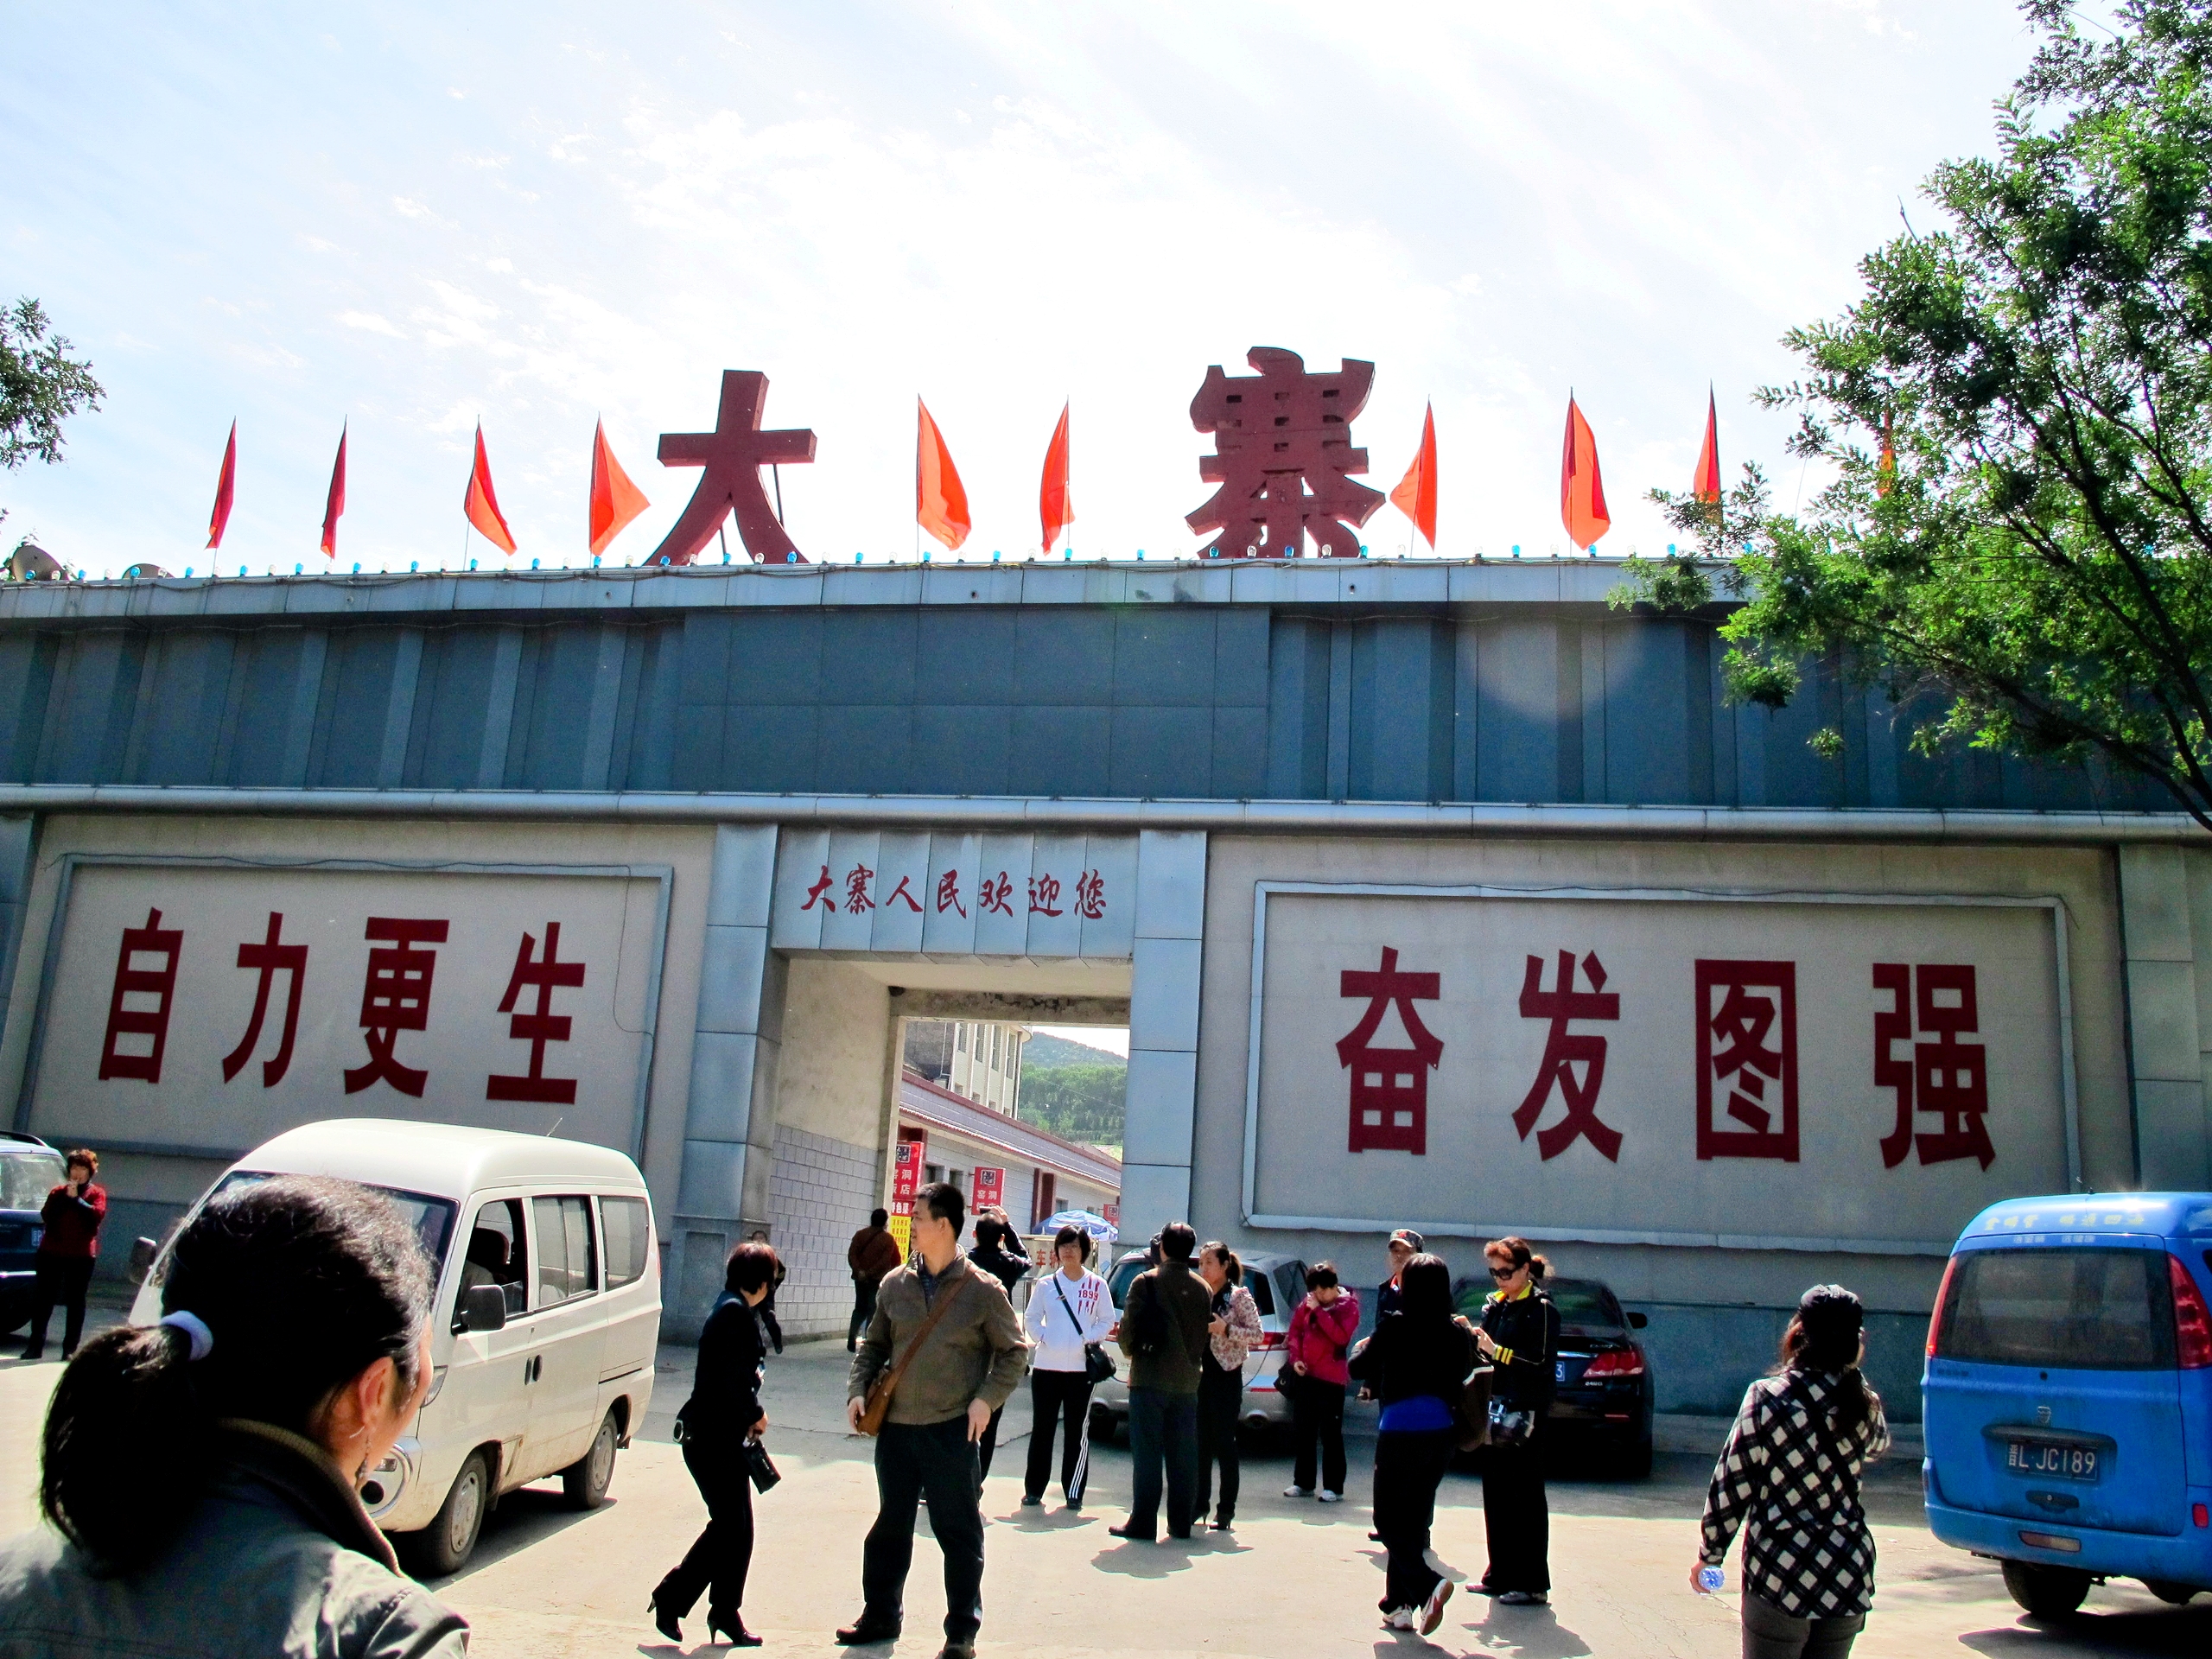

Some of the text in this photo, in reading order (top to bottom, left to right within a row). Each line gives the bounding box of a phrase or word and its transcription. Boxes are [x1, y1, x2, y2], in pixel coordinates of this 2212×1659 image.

[644, 346, 1386, 564] 大寨
[801, 863, 1107, 919] 大寨人民欢迎您
[99, 907, 586, 1104] 自力更生
[1336, 945, 1996, 1172] 奋发图强
[1078, 1289, 1098, 1301] 1899
